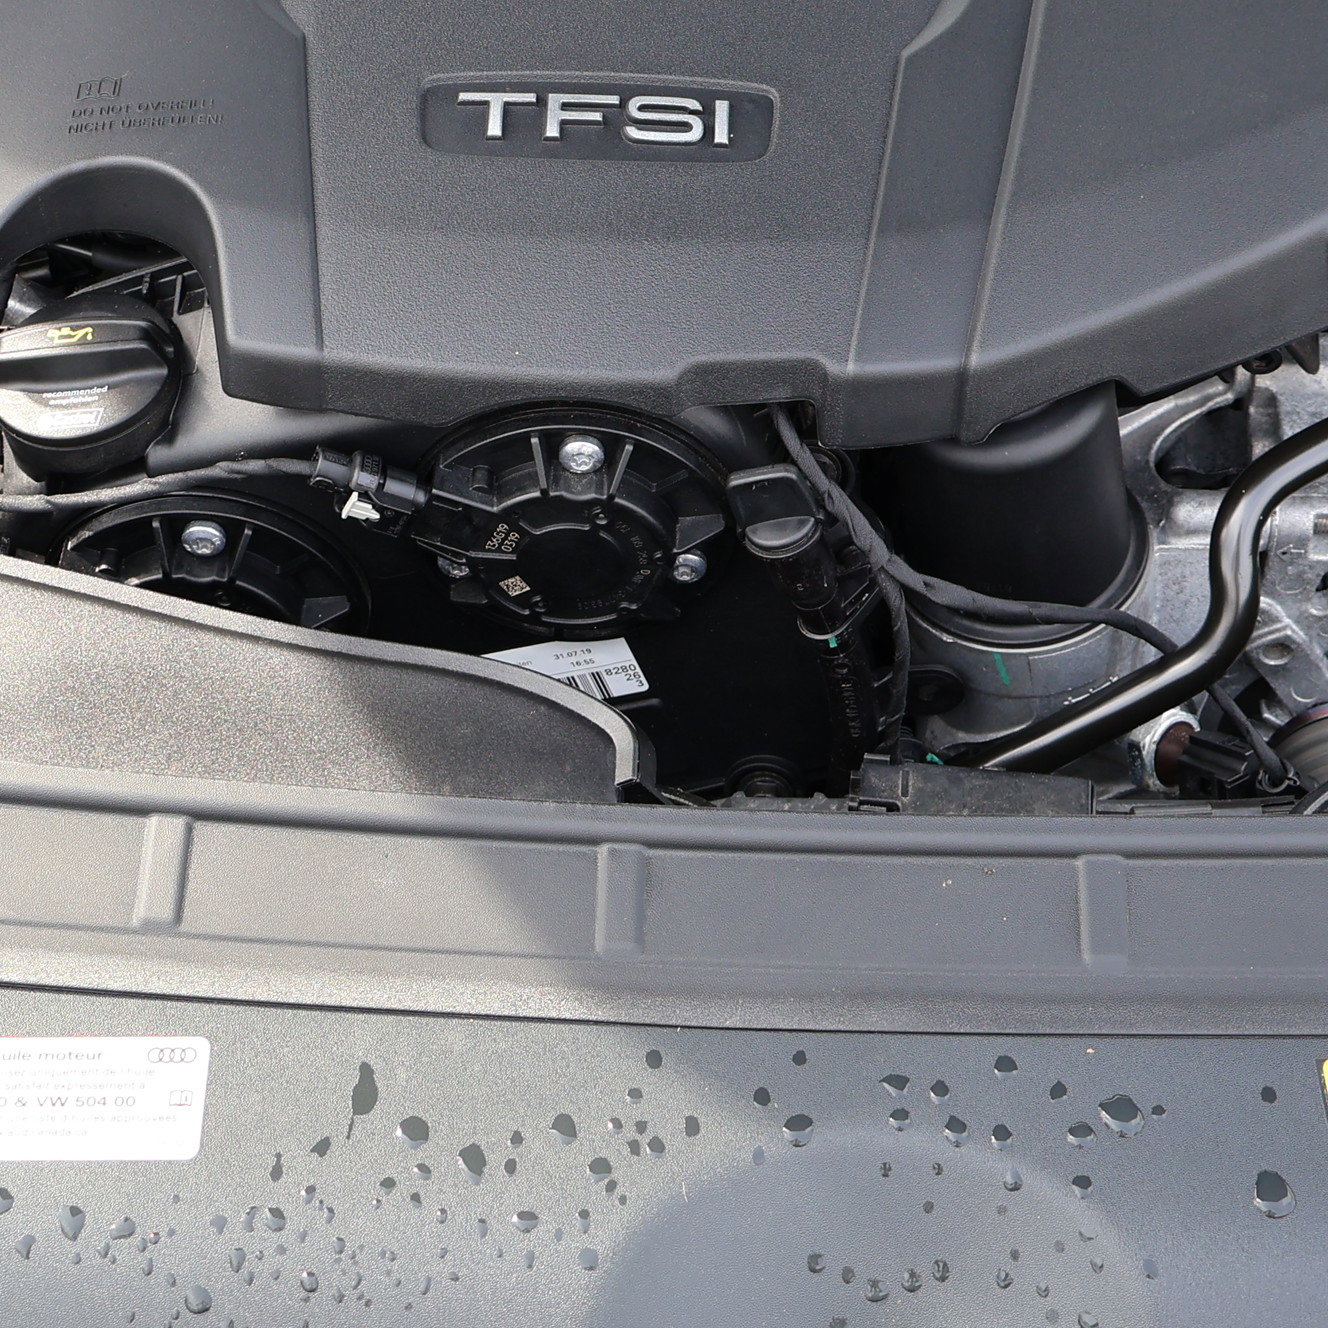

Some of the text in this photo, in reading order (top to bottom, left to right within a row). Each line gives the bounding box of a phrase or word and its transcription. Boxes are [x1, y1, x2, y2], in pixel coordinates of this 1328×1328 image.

[71, 108, 94, 118] DO
[100, 104, 130, 115] NOT
[68, 119, 116, 134] NICHT
[456, 92, 733, 149] TFSI
[42, 385, 109, 399] recommended
[485, 523, 510, 551] 136G19
[501, 532, 521, 552] 0319
[553, 648, 592, 660] 31.07.19
[604, 664, 638, 676] 8280
[626, 672, 642, 682] 26
[636, 679, 645, 688] 3
[38, 1051, 103, 1061] moteur
[14, 1096, 28, 1108] &
[37, 1096, 69, 1108] VW
[75, 1096, 107, 1108] 504
[114, 1096, 136, 1108] 00
